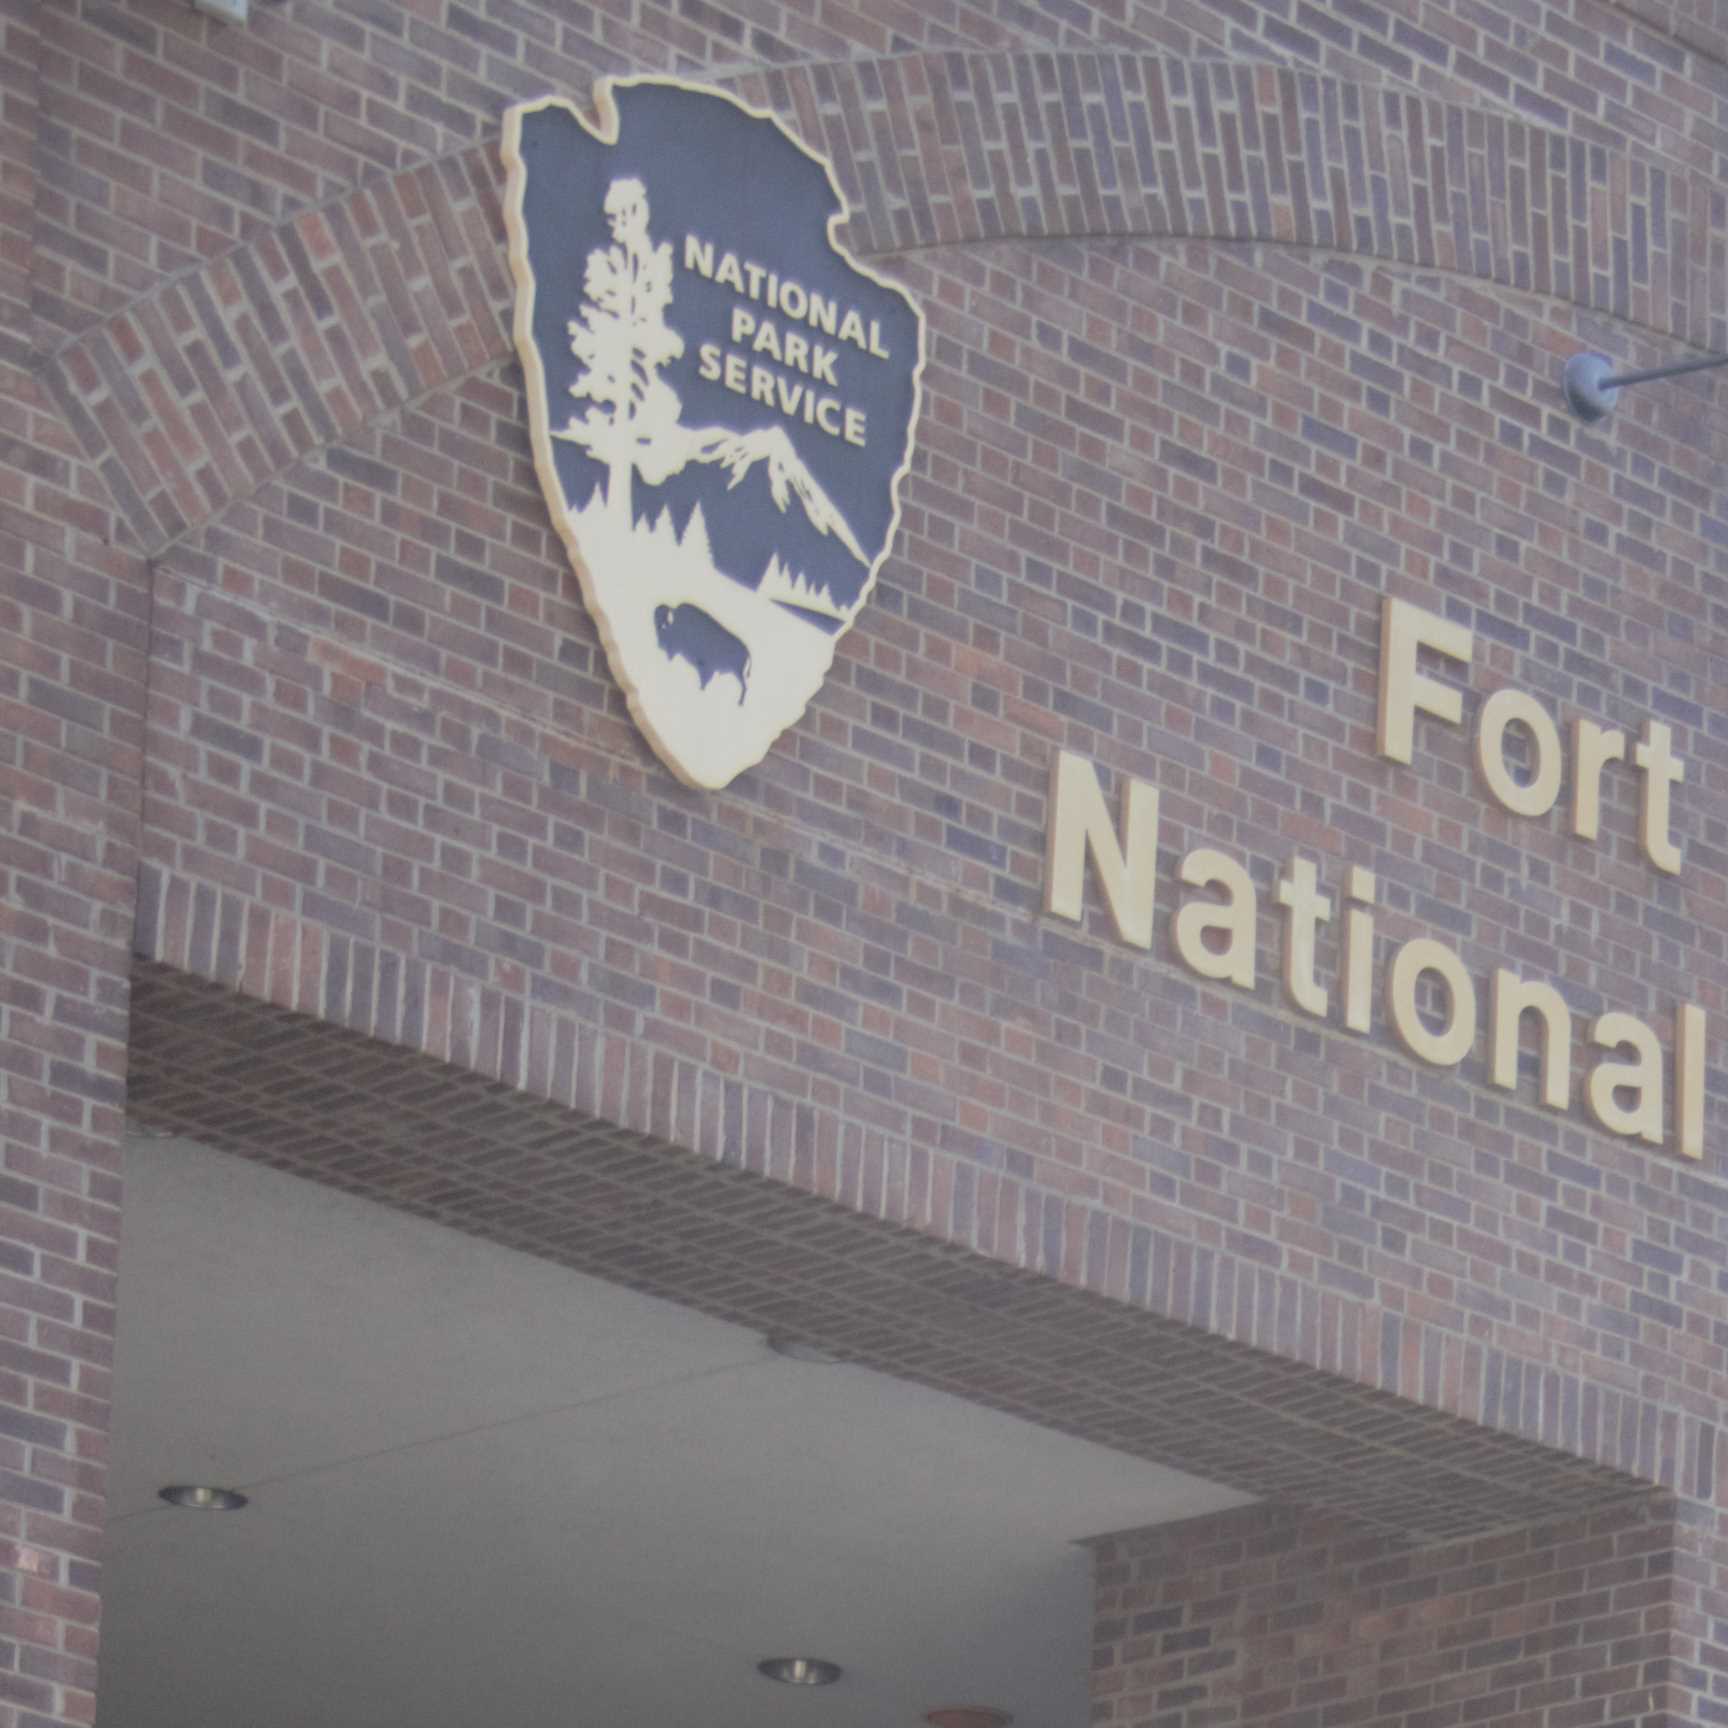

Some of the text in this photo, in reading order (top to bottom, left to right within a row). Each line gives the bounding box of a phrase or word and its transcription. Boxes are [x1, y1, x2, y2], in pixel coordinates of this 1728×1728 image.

[685, 234, 891, 360] NATIONAL
[731, 307, 840, 387] PARK
[697, 342, 867, 448] SERVICE
[1377, 596, 1686, 876] Fort
[1044, 750, 1707, 1160] National
